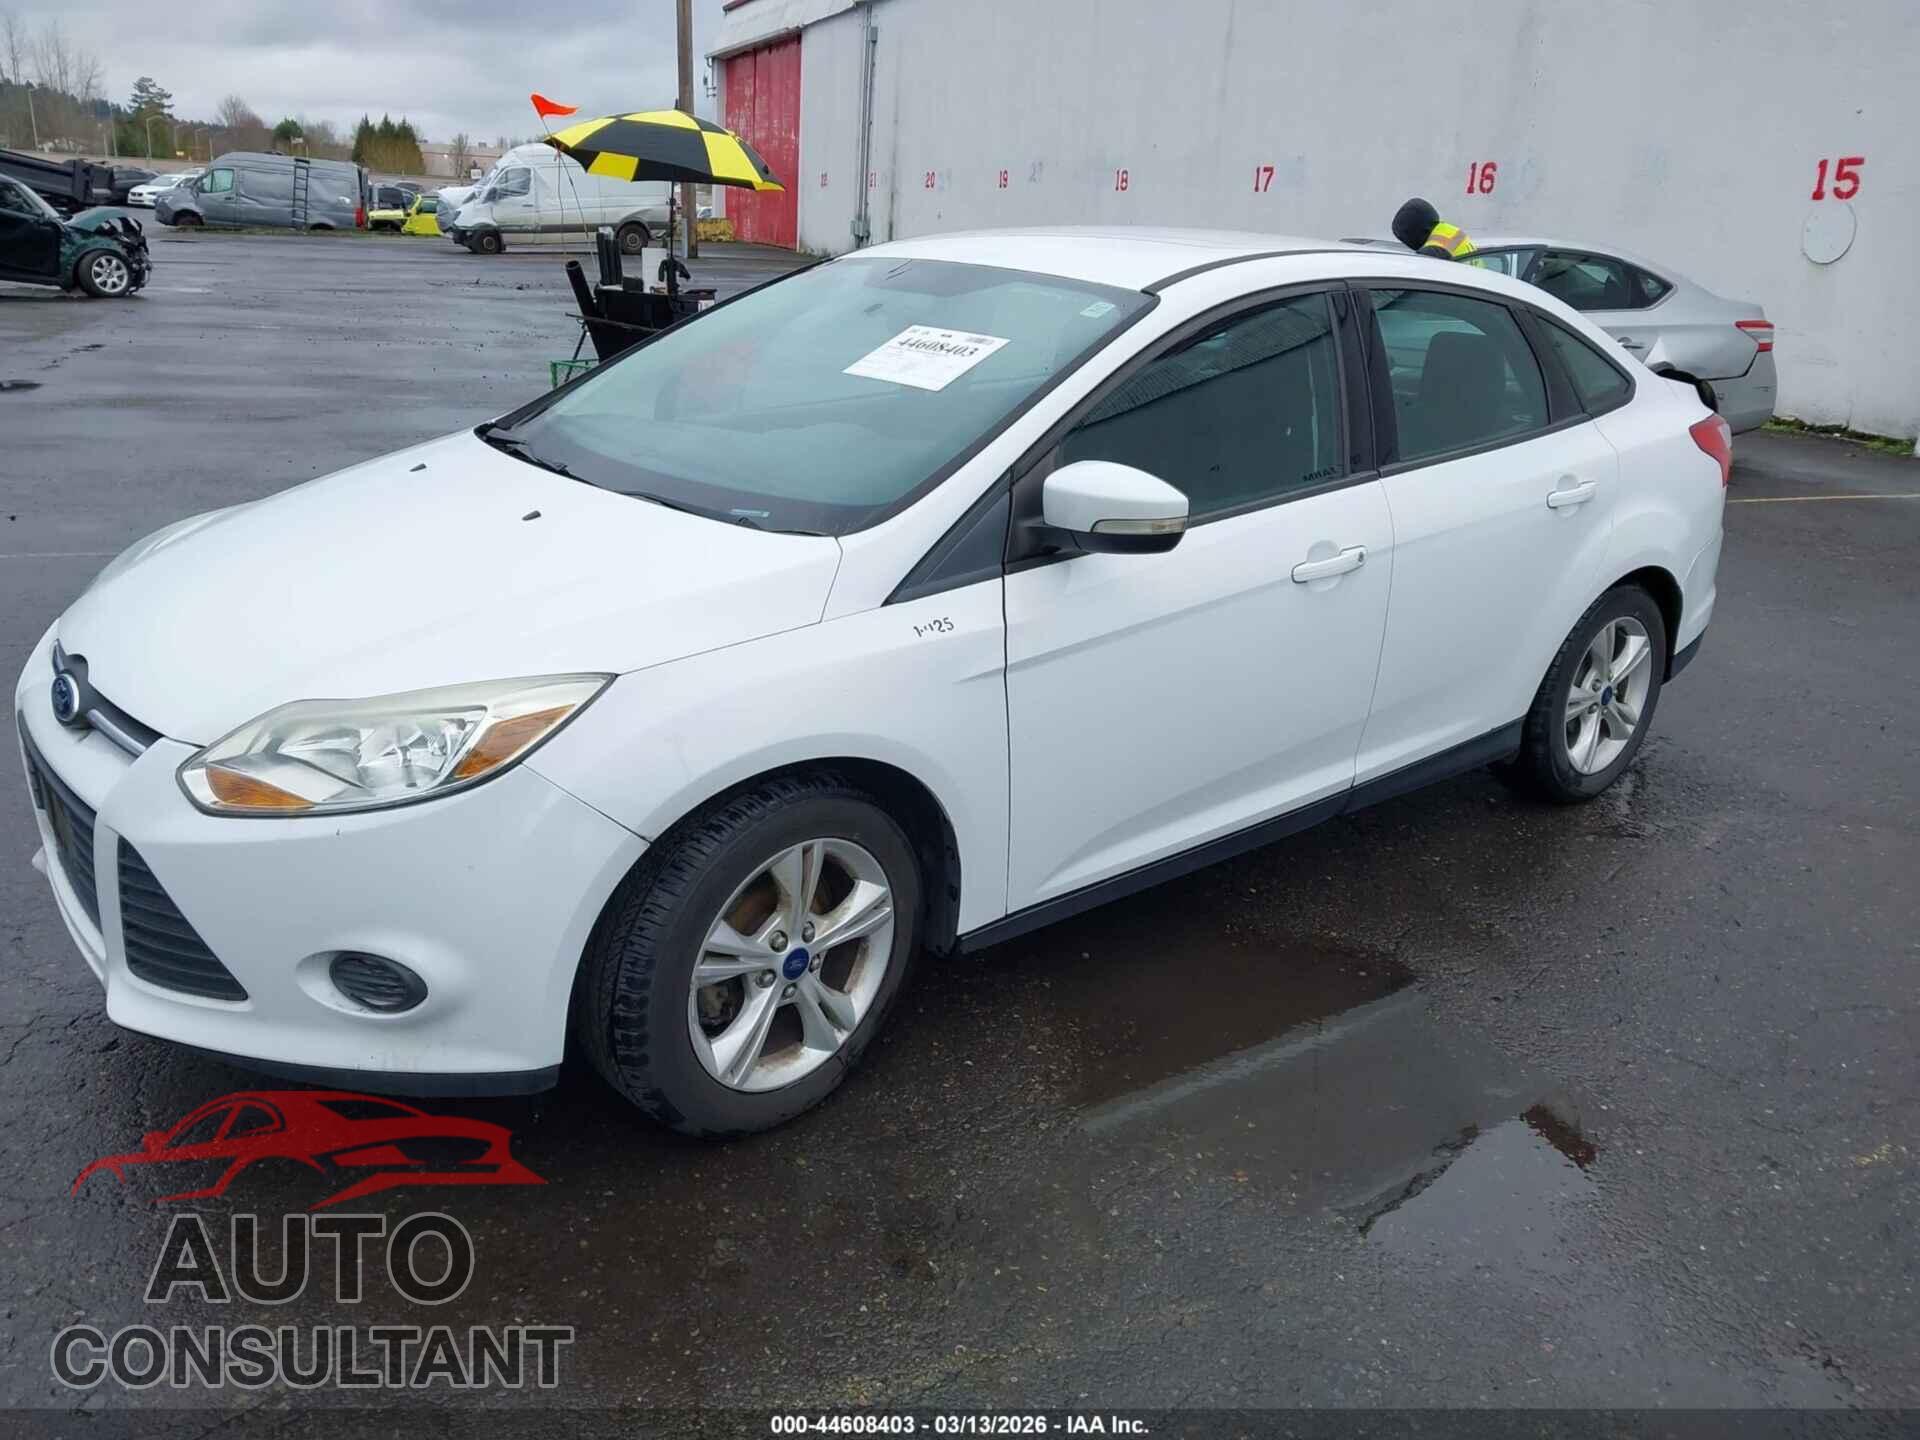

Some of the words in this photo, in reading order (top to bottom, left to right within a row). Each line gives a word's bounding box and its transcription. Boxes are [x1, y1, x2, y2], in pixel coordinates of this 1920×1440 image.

[924, 171, 936, 188] 20
[999, 169, 1009, 189] 19
[1114, 169, 1129, 191] 18
[1254, 165, 1275, 192] 17
[1466, 161, 1498, 195] 16
[1811, 156, 1866, 201] 15
